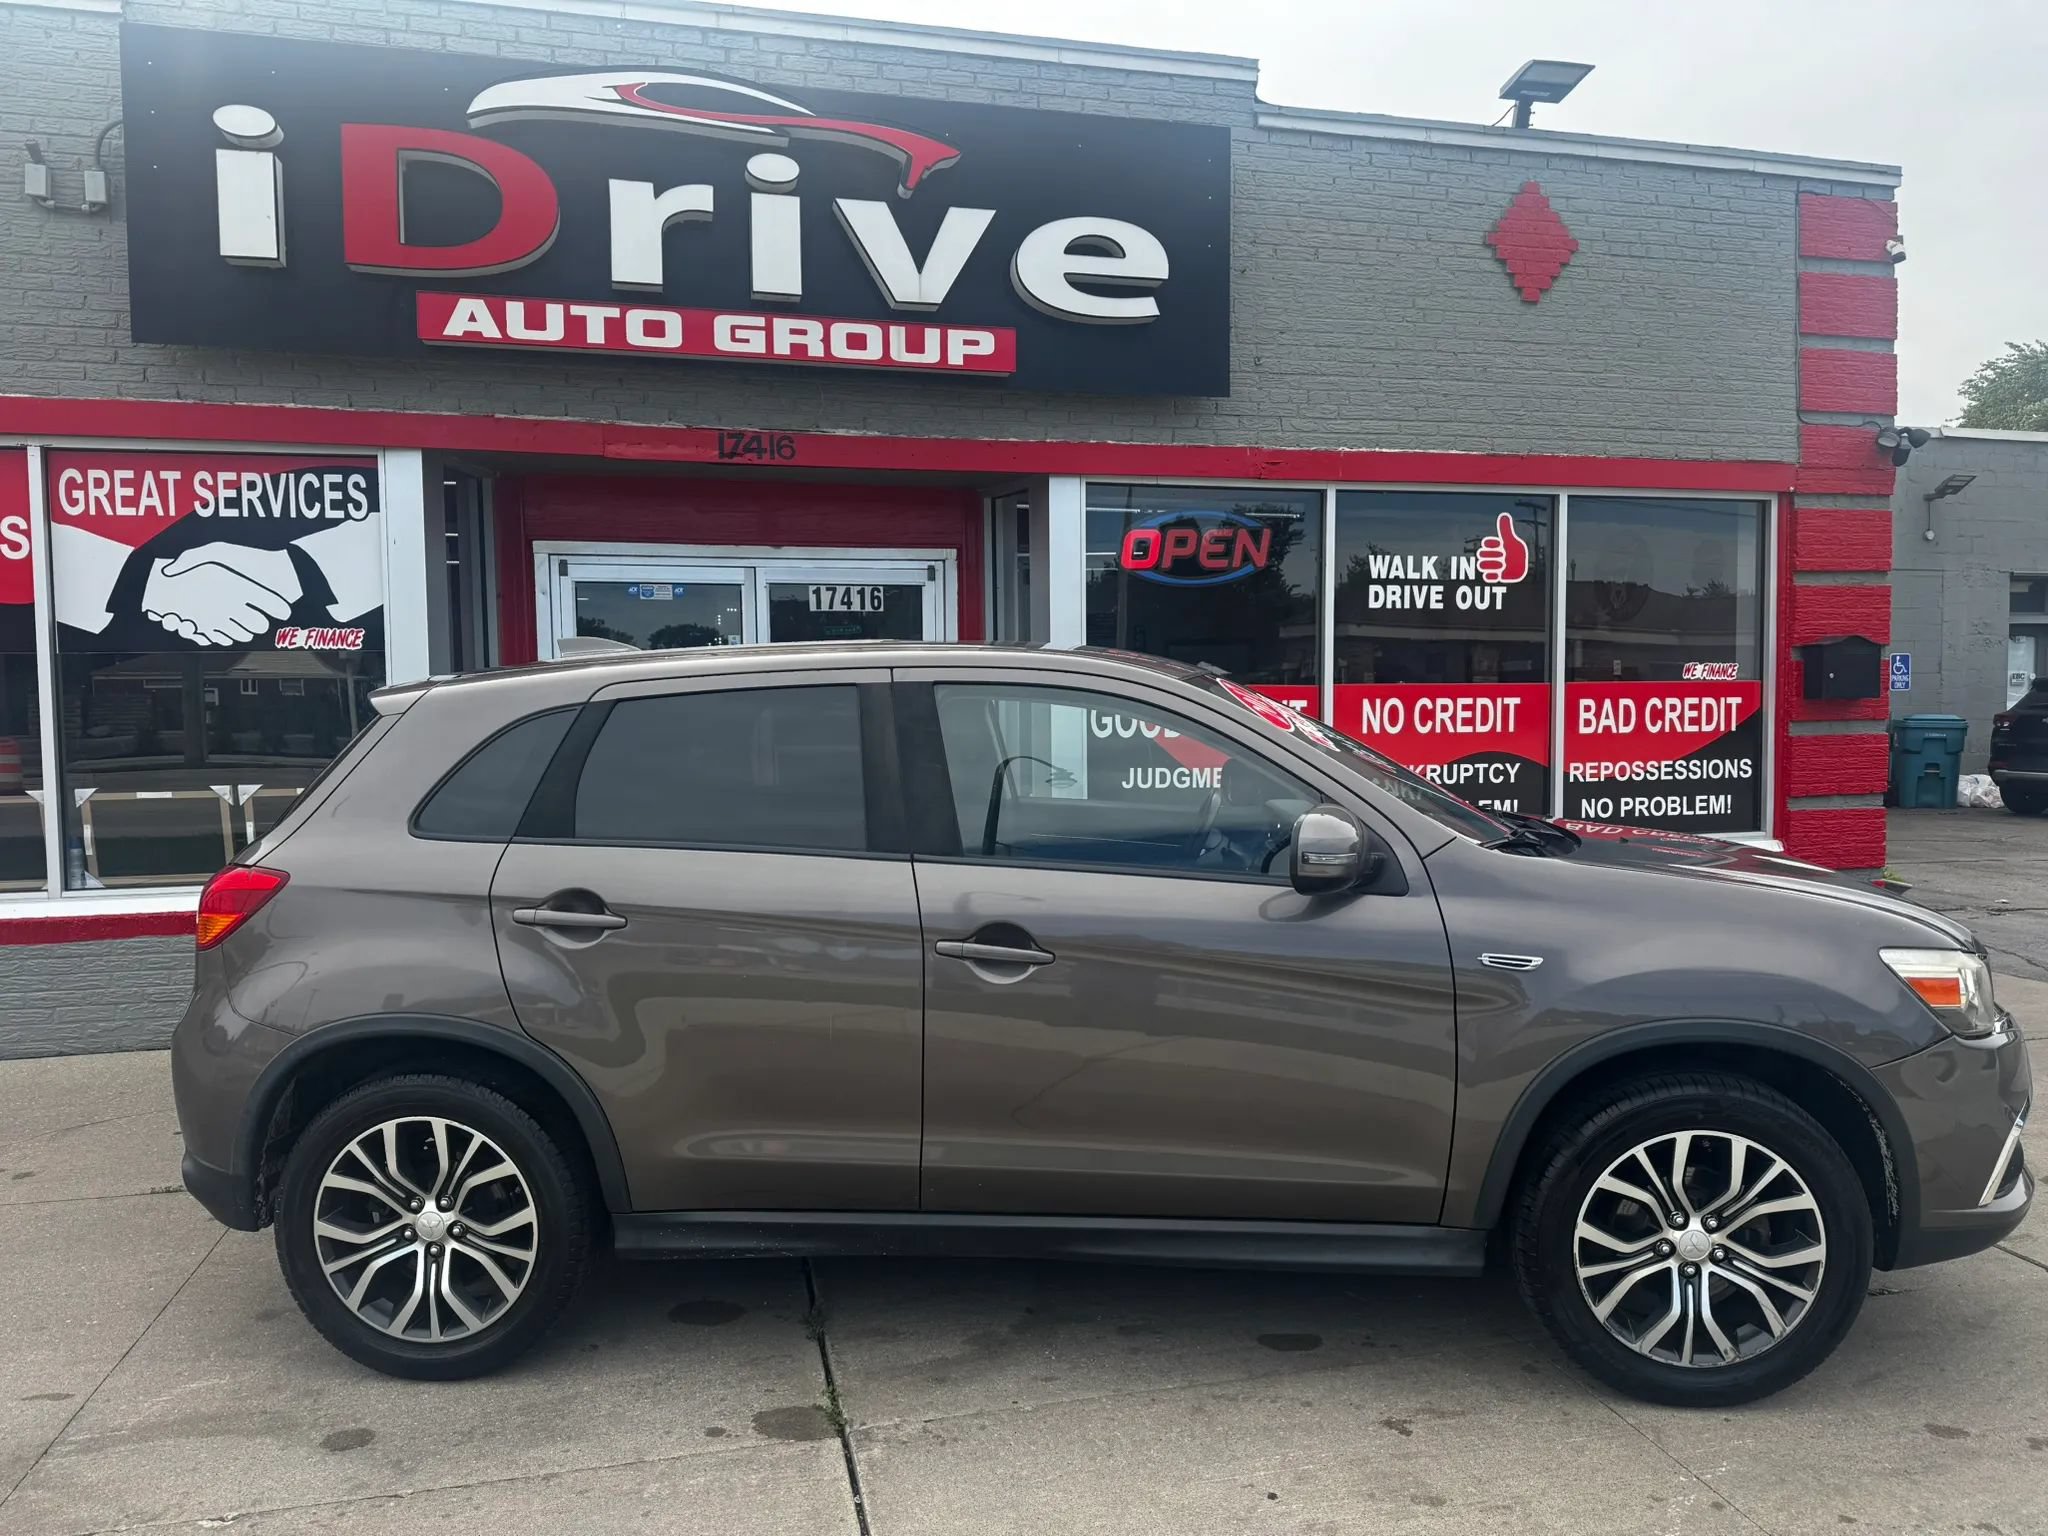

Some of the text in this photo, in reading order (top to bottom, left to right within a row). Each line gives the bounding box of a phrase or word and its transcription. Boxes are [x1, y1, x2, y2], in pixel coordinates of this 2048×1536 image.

[443, 298, 995, 366] AUTO GROUP
[718, 431, 797, 461] 17416
[58, 467, 369, 520] GREAT SERVICES
[1120, 528, 1272, 571] OPEN
[1368, 554, 1475, 580] WALK IN
[811, 586, 882, 611] 17416
[1368, 585, 1507, 610] DRIVE OUT
[275, 627, 365, 649] WE FINANCE
[1683, 662, 1739, 680] WE FINANCE
[1362, 698, 1405, 735] NO
[1413, 697, 1521, 734] CREDIT
[1578, 697, 1743, 735] BAD CREDIT
[1569, 758, 1753, 783] REPOSSESSIONS
[1581, 795, 1732, 819] NO PROBLEM!
